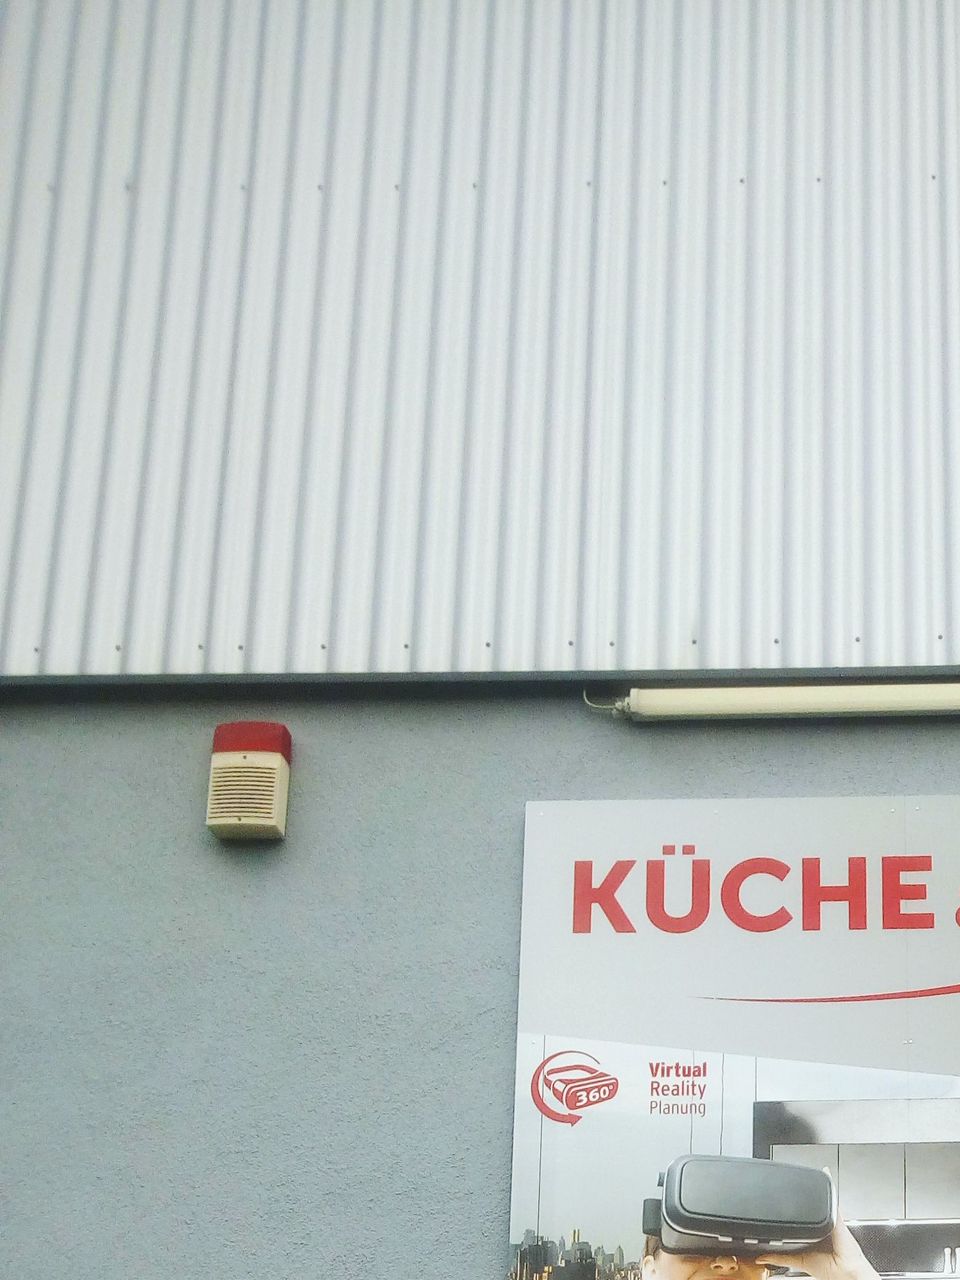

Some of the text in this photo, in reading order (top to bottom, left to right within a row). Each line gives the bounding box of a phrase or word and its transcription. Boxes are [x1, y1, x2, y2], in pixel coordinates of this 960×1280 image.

[571, 844, 936, 935] KÜCHE
[649, 1061, 707, 1077] Virtual
[650, 1080, 707, 1099] Reality
[650, 1100, 706, 1117] Planung
